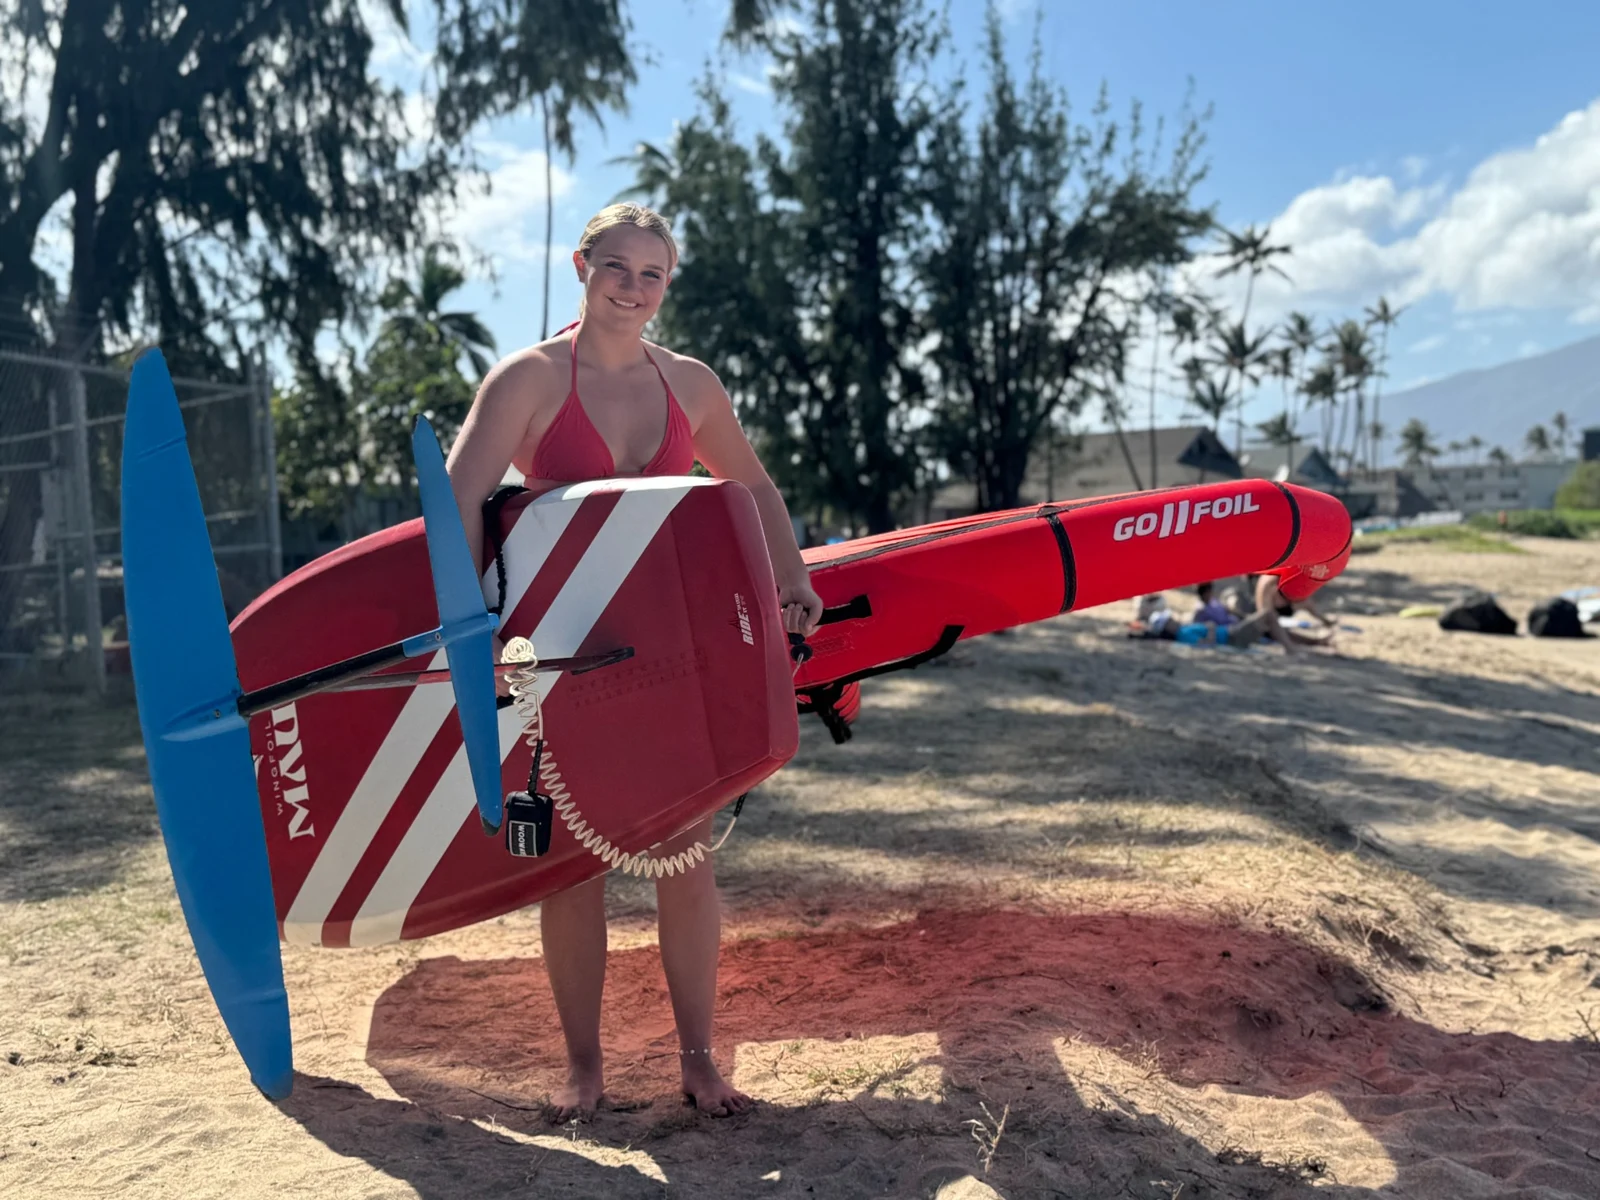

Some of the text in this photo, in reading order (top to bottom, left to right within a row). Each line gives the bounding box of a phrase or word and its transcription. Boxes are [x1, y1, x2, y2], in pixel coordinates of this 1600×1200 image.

[1191, 492, 1261, 525] FOIL
[738, 611, 754, 646] RIDE
[264, 720, 284, 816] WINGFOIL
[271, 700, 316, 840] MAU
